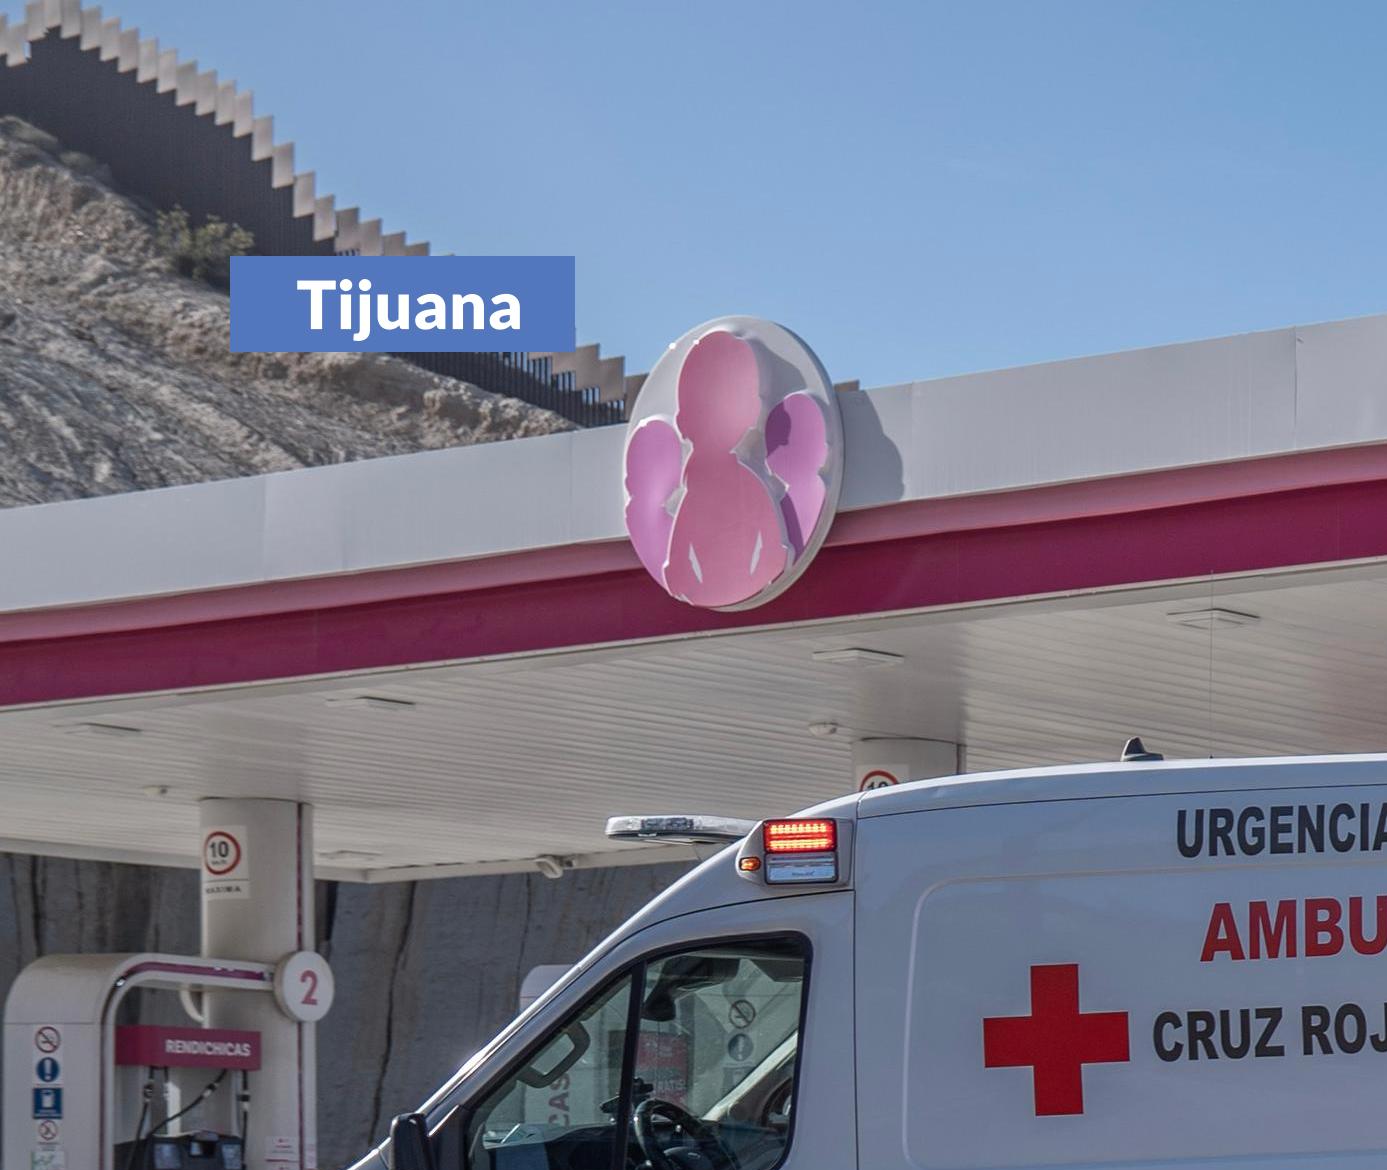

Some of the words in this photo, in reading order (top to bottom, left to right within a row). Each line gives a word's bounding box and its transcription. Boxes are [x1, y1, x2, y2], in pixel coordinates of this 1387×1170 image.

[209, 840, 230, 858] 10
[300, 970, 319, 1006] 2
[165, 1038, 251, 1057] RENDICHICAS
[1153, 1007, 1285, 1063] CRUZ
